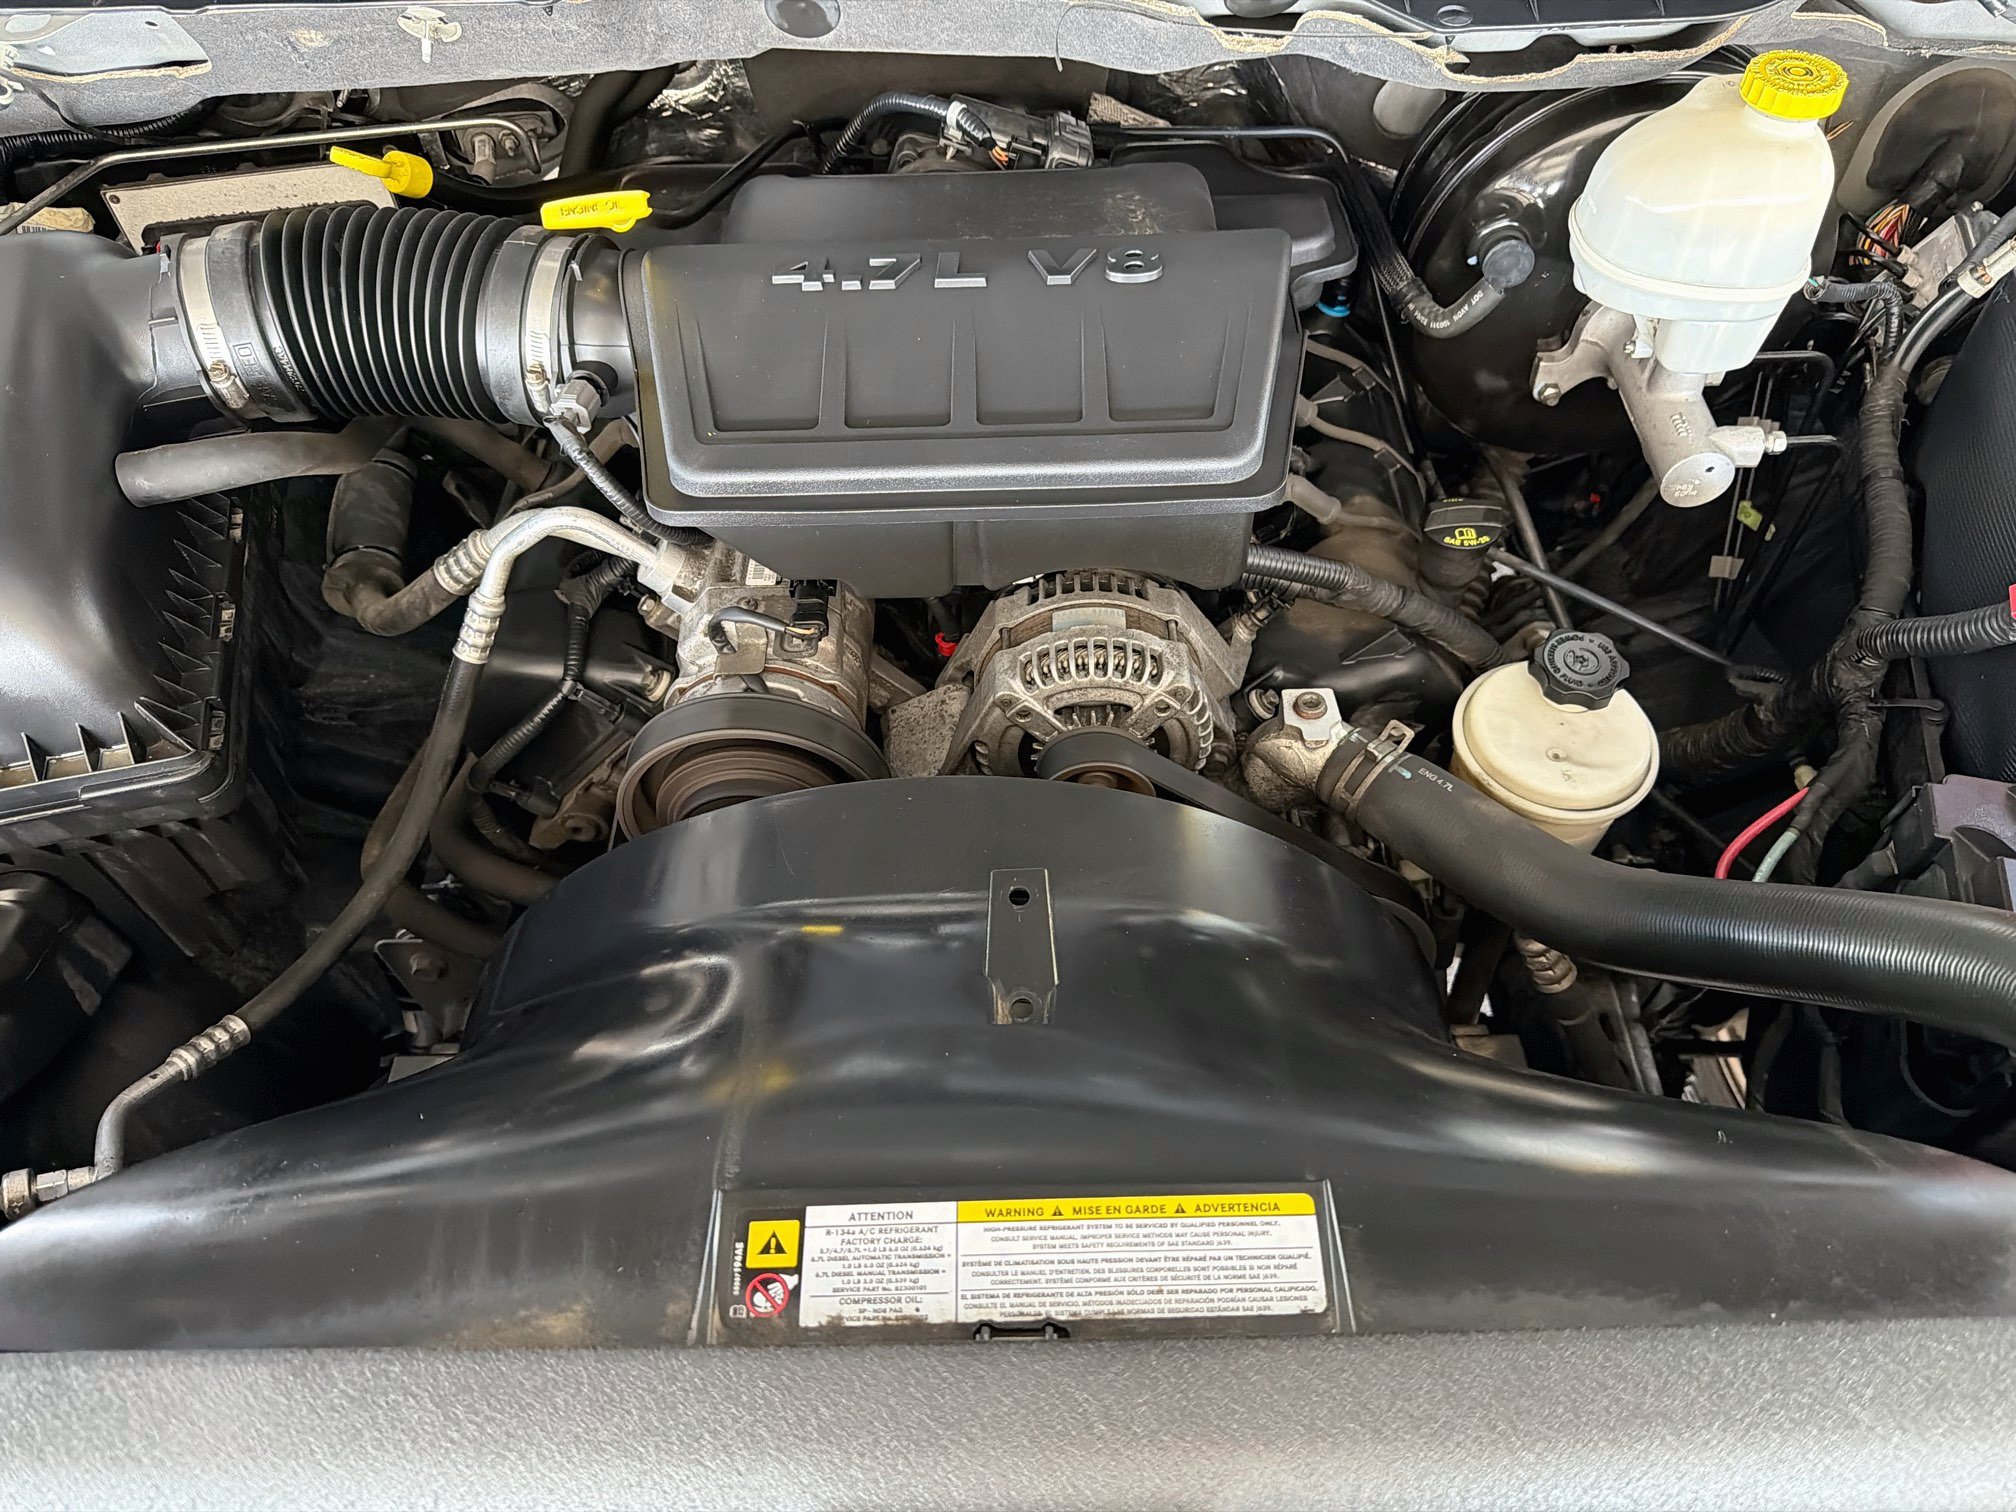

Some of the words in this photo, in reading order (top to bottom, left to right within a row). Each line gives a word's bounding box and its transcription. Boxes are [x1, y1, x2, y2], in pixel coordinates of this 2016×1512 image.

[771, 250, 988, 291] 4.7L
[1027, 247, 1163, 285] V8
[1444, 536, 1461, 546] SAE
[1598, 642, 1612, 654] USE
[1560, 673, 1584, 687] FLUID
[1418, 768, 1438, 781] ENG
[1436, 779, 1454, 792] 4.7L
[985, 1206, 1044, 1217] WARNING
[1072, 1205, 1101, 1215] MISE
[1105, 1205, 1120, 1214] EN
[1125, 1204, 1166, 1214] GARDE
[1194, 1201, 1280, 1213] ADVERTENCIA
[848, 1210, 913, 1221] ATTENTION
[878, 1226, 938, 1234] REFRIGERANT
[839, 1296, 902, 1304] COMPRESSOR
